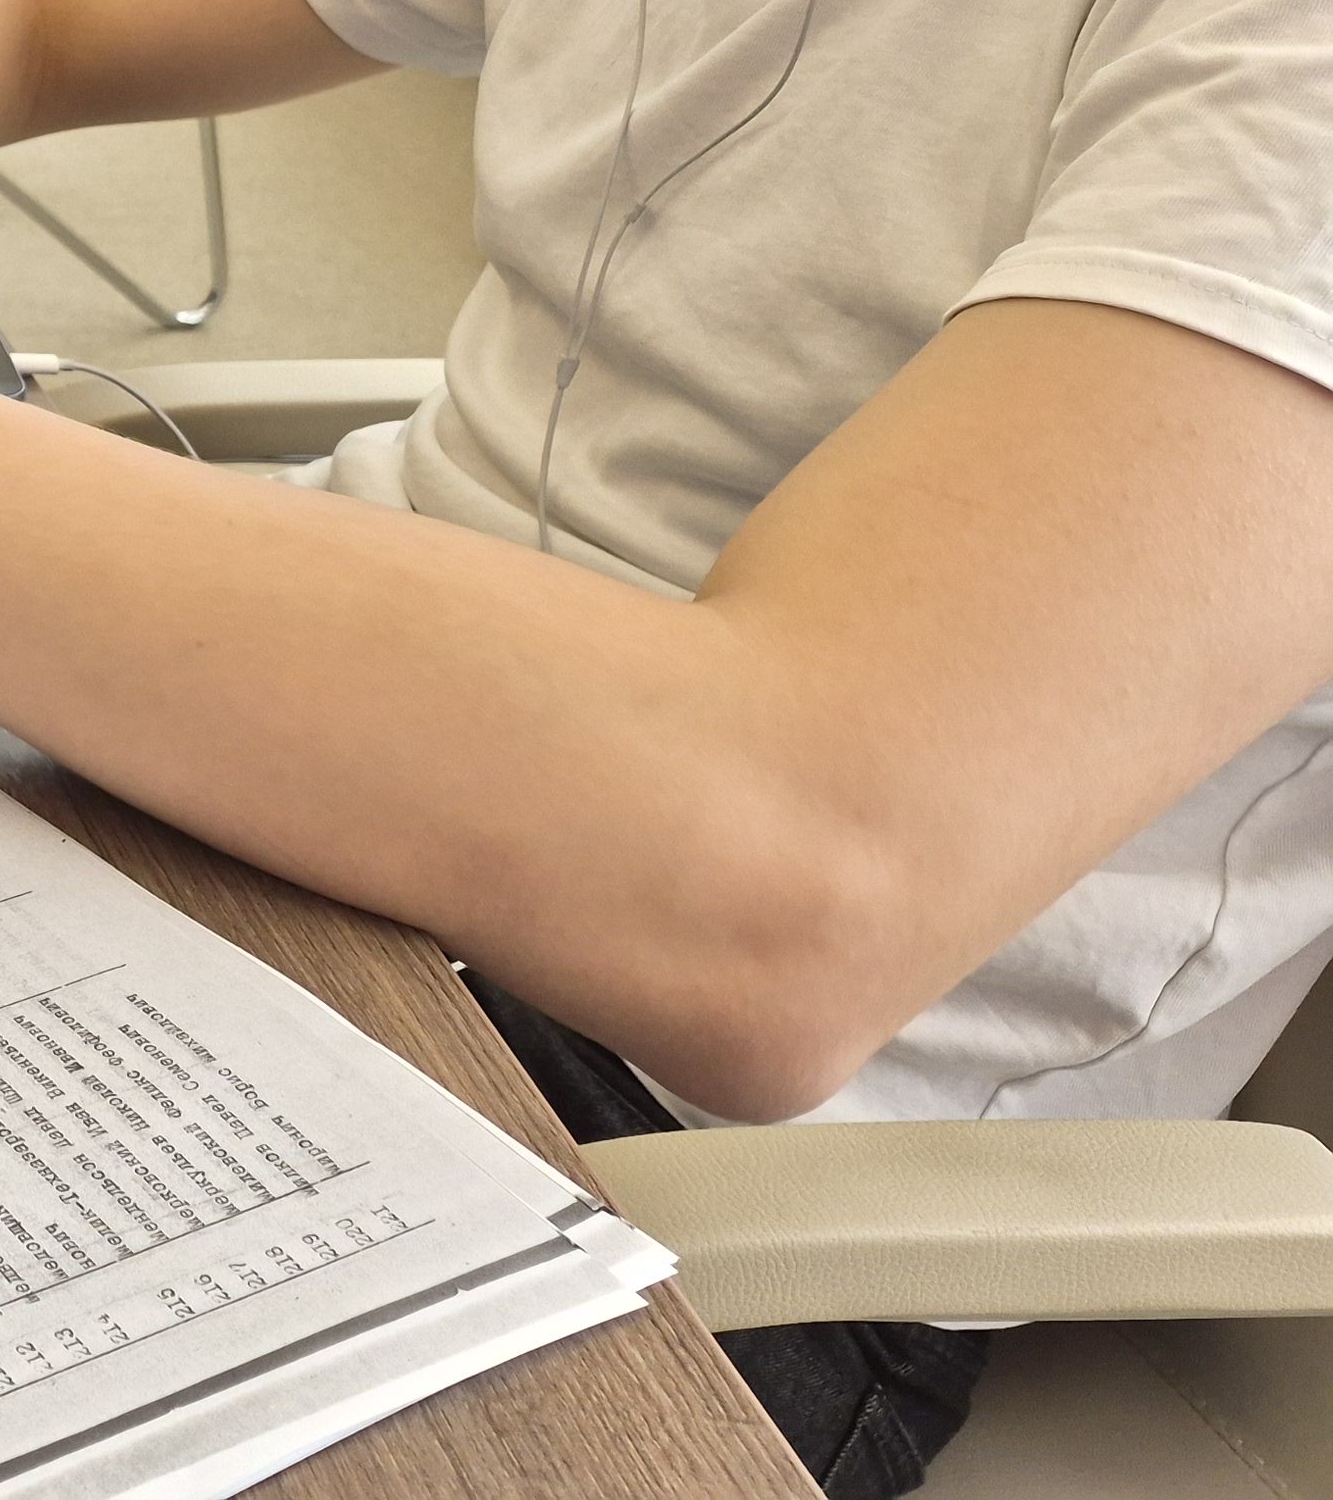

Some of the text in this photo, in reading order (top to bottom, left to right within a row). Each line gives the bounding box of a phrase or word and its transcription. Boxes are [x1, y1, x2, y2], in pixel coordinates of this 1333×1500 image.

[117, 1023, 200, 1091] Семенович
[80, 1074, 151, 1133] Николай
[126, 1069, 182, 1119] Феликс
[217, 1067, 270, 1112] Борис
[22, 1106, 75, 1150] Давид
[64, 1101, 109, 1139] Иван
[200, 1093, 255, 1141] Павел
[182, 1122, 281, 1206] Милевский
[72, 1152, 176, 1247] Мендельсон
[44, 1222, 97, 1271] нович
